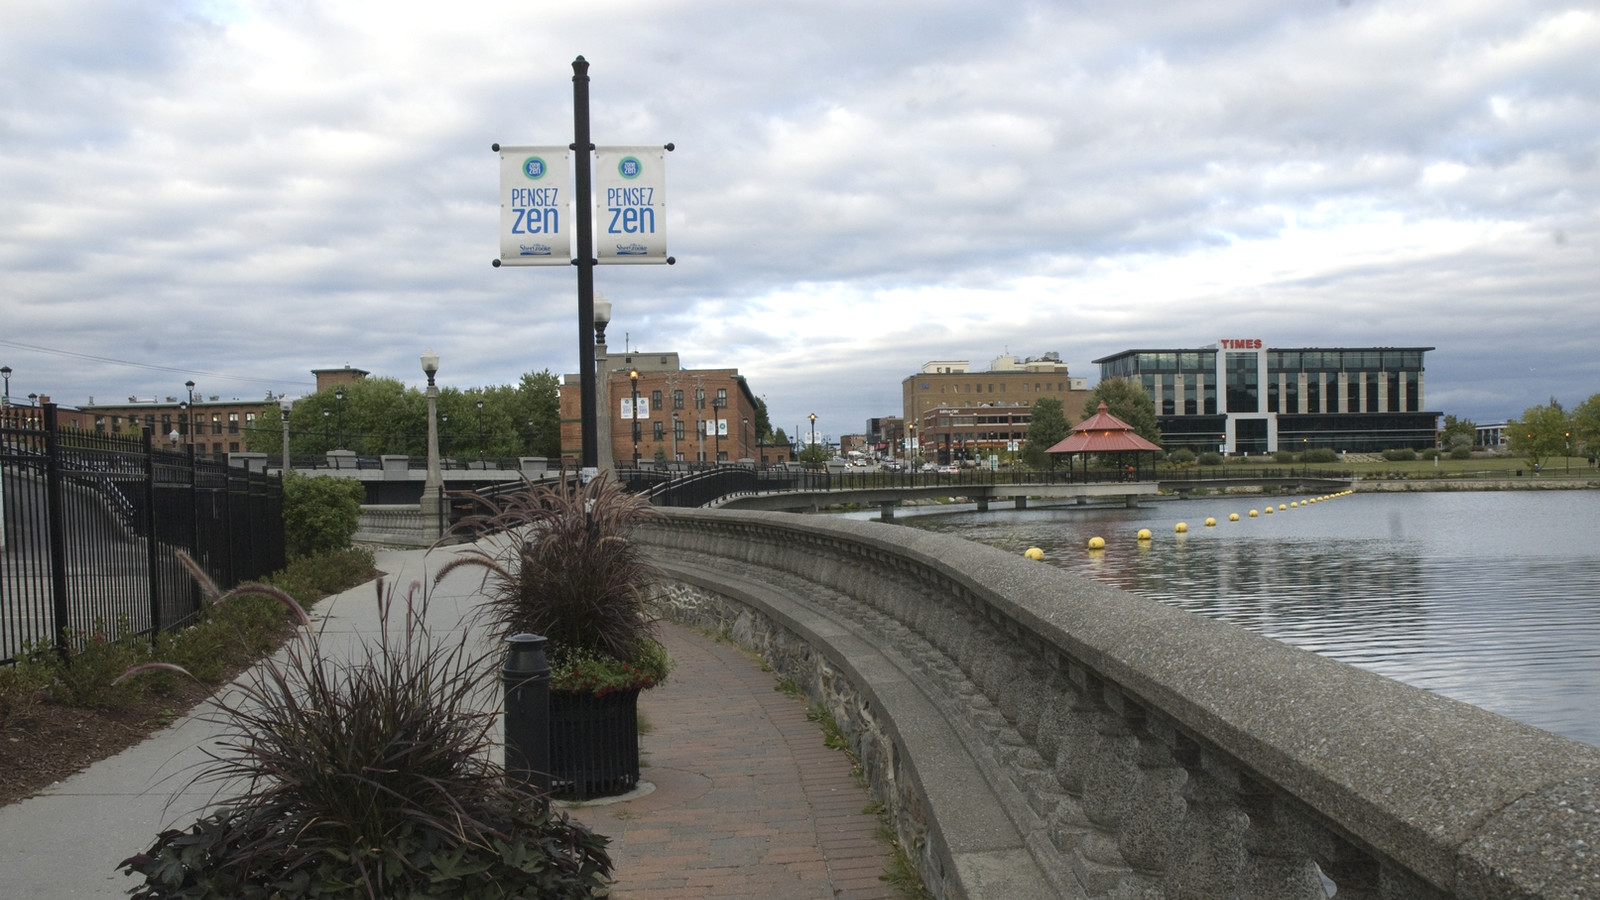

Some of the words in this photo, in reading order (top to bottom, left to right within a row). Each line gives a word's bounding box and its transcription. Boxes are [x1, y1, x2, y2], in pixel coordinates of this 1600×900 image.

[512, 188, 559, 207] PENSEZ
[607, 187, 654, 206] PENSEZ
[511, 208, 559, 234] zen
[608, 207, 655, 234] zen
[1221, 339, 1262, 349] TIMES
